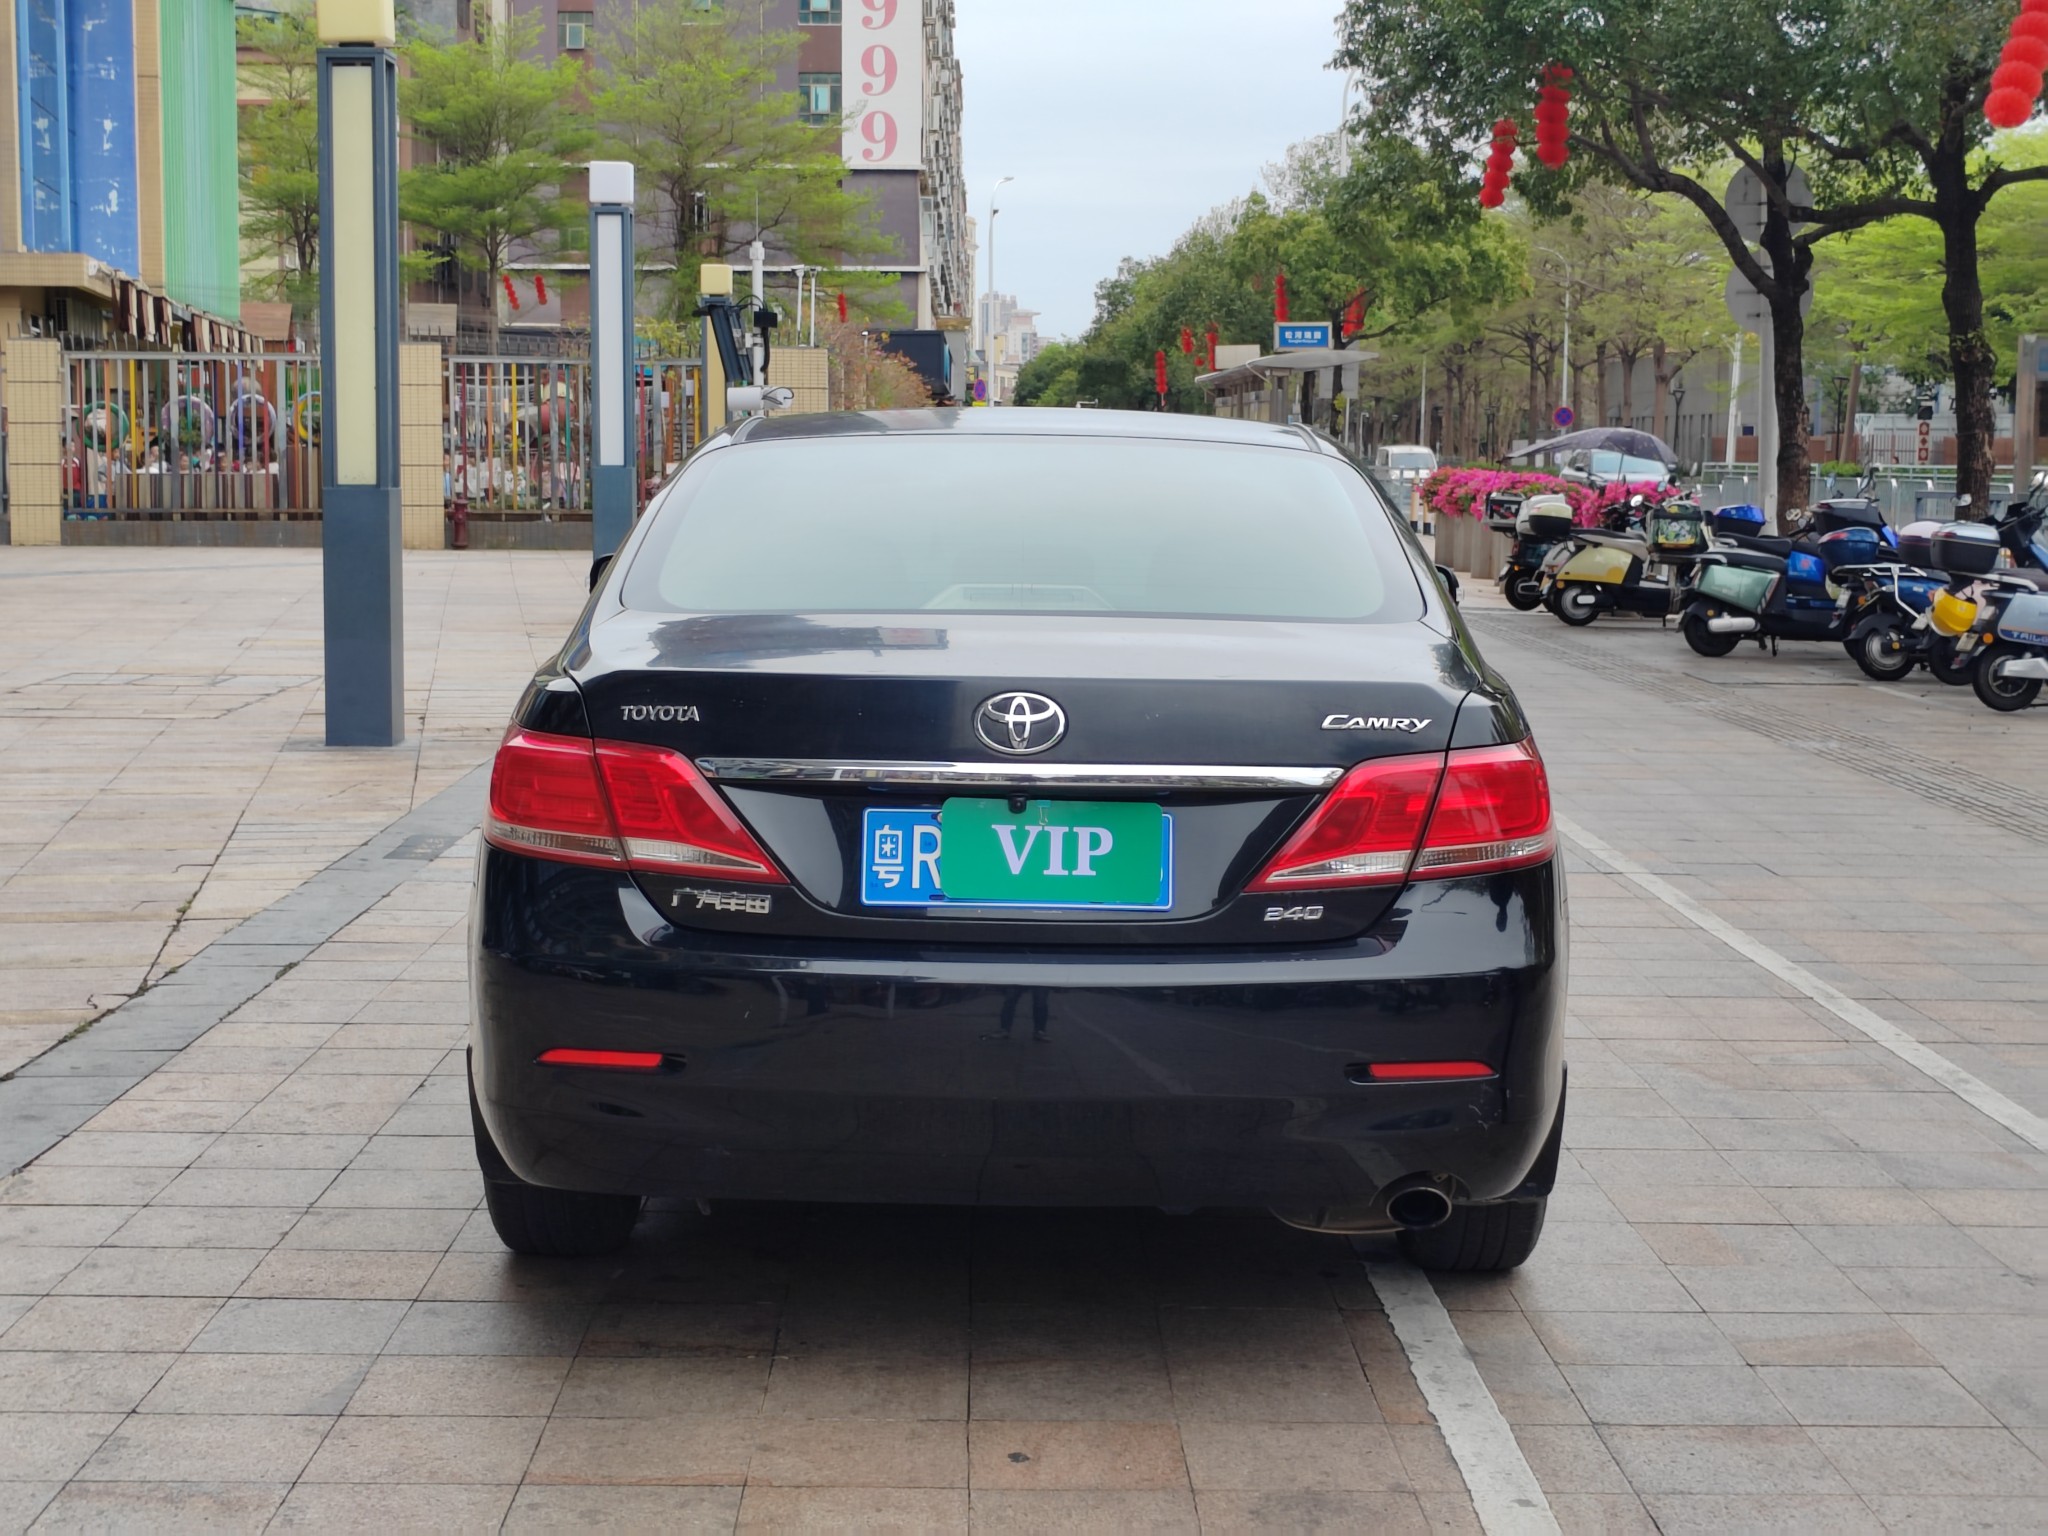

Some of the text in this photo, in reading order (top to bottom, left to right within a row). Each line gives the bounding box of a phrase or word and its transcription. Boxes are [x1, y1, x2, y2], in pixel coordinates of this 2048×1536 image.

[620, 704, 700, 722] TOYOTA
[1321, 714, 1432, 733] CAMRY
[991, 823, 1114, 877] VIP
[671, 887, 771, 914] 广汽丰田
[1263, 905, 1324, 922] 240
